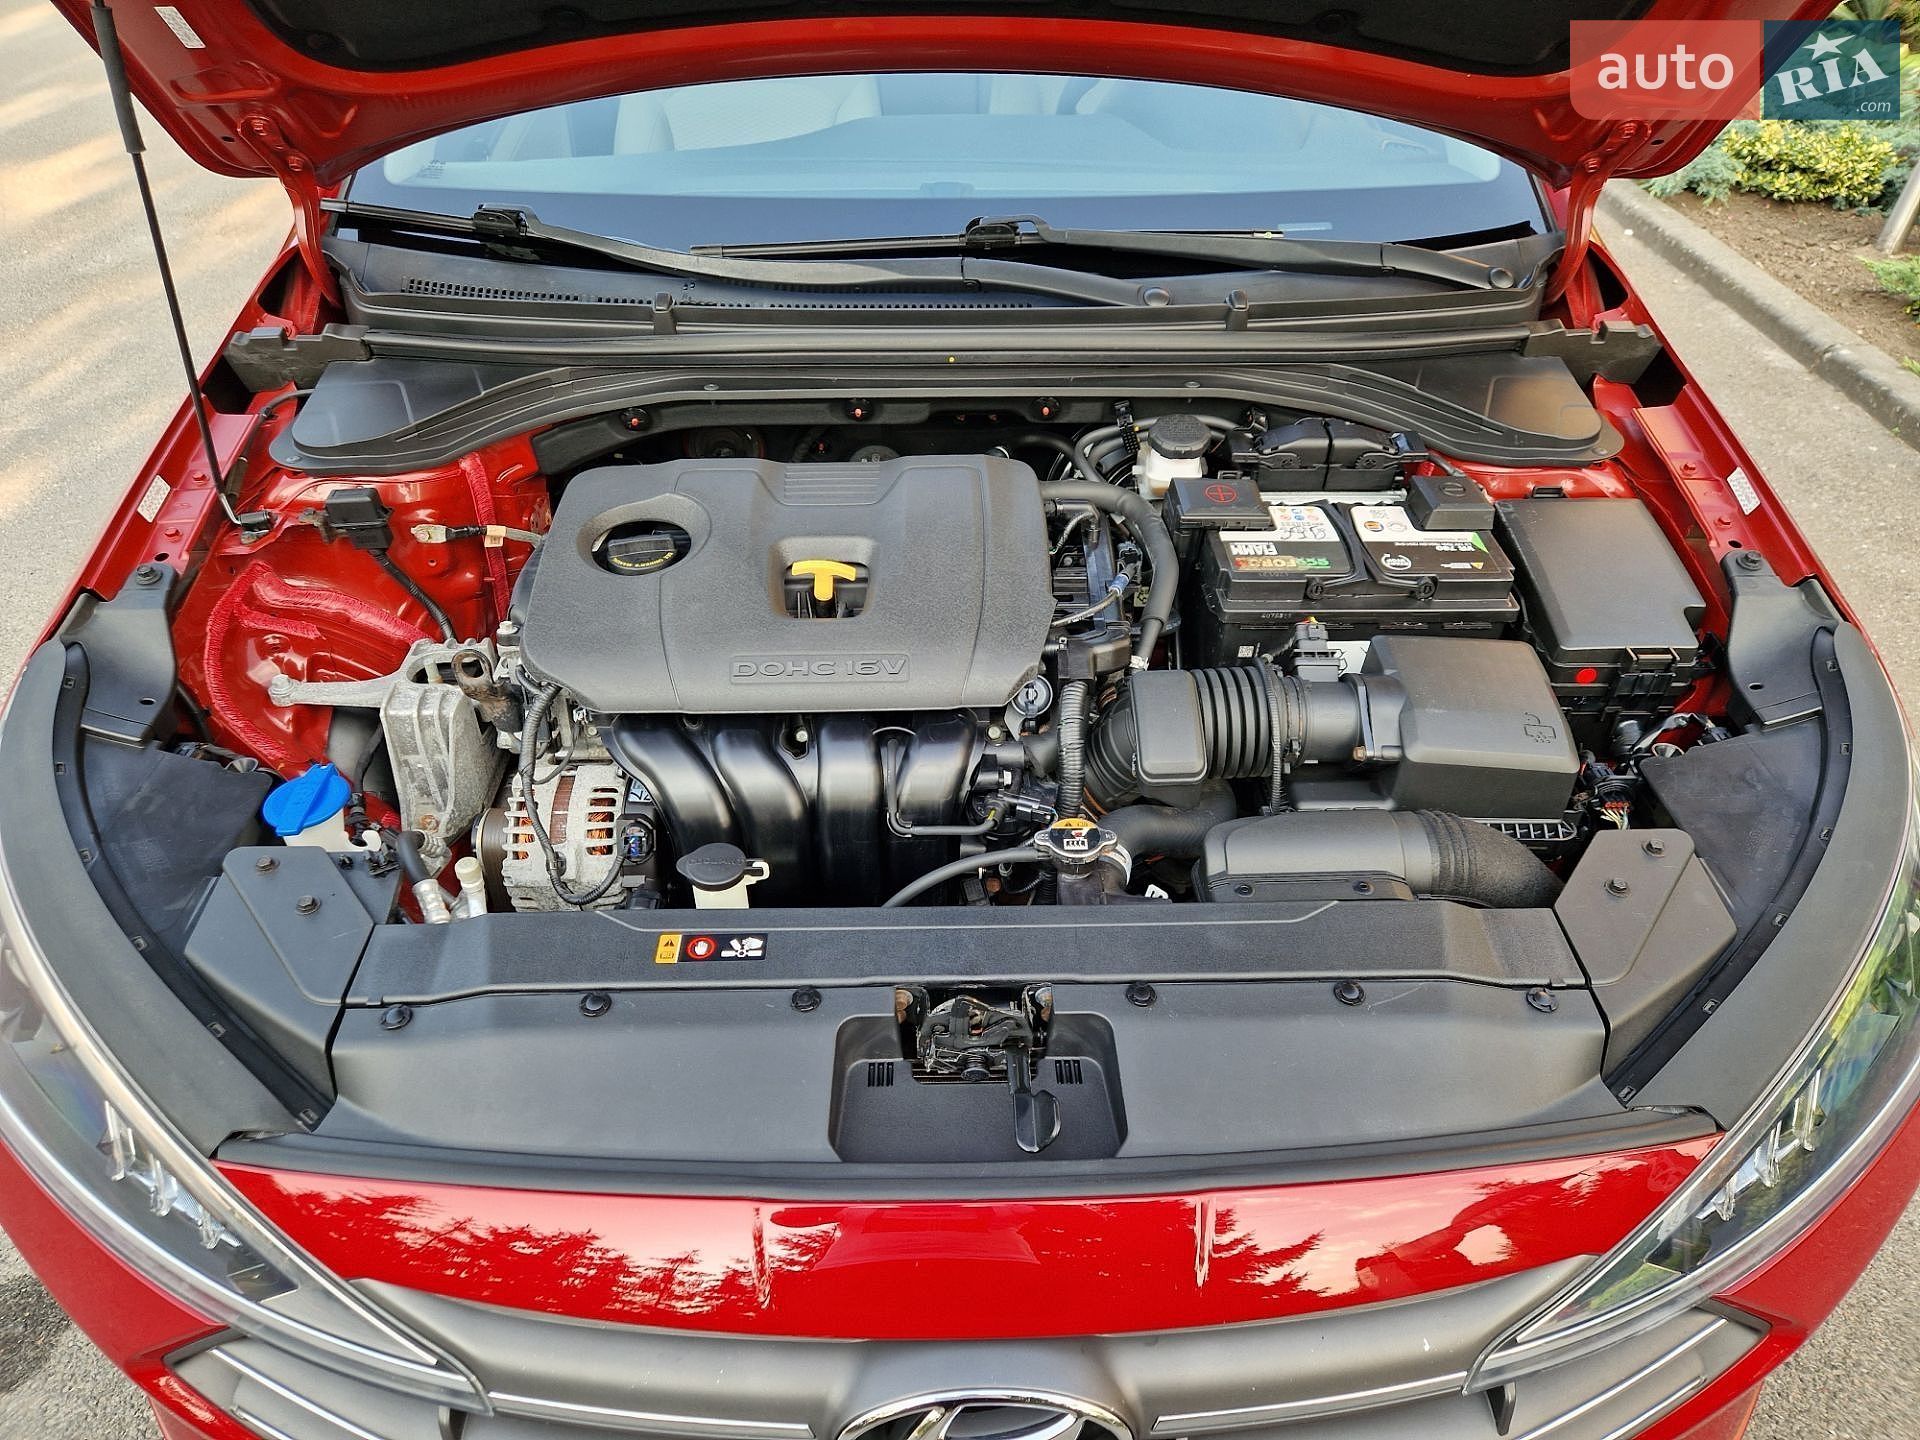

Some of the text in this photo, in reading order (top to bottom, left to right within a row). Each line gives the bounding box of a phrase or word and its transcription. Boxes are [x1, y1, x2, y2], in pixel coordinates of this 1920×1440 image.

[1230, 541, 1279, 556] FIAMM
[733, 658, 906, 677] DOHC 16V
